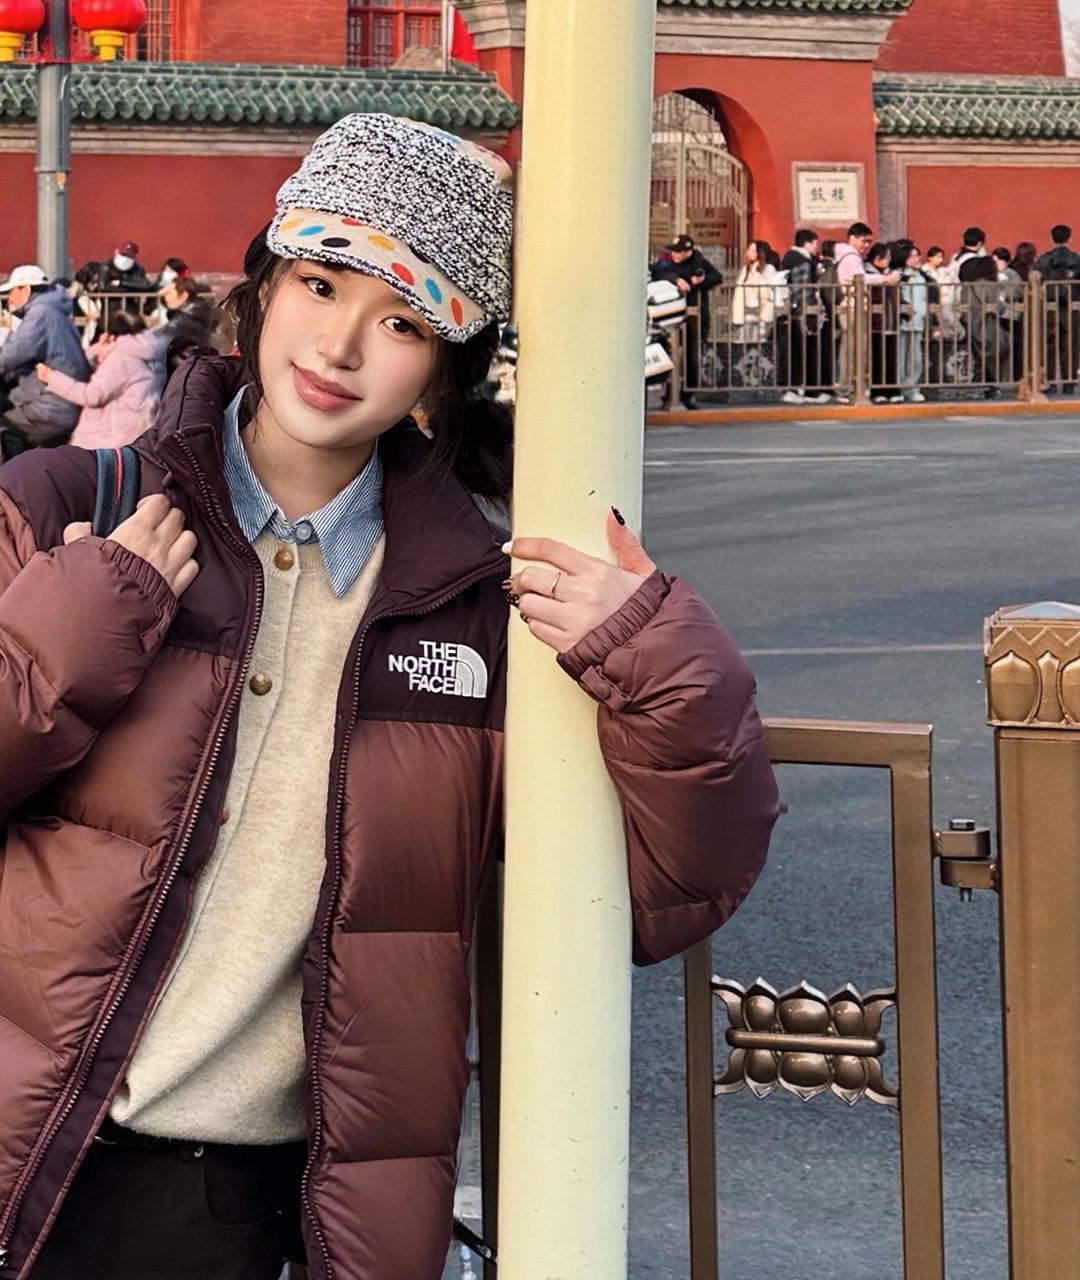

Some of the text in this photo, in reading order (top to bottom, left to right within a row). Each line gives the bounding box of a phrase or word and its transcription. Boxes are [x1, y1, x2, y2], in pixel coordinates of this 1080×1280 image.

[419, 640, 459, 660] THE
[388, 654, 456, 677] NORTH
[409, 673, 456, 695] FACE
